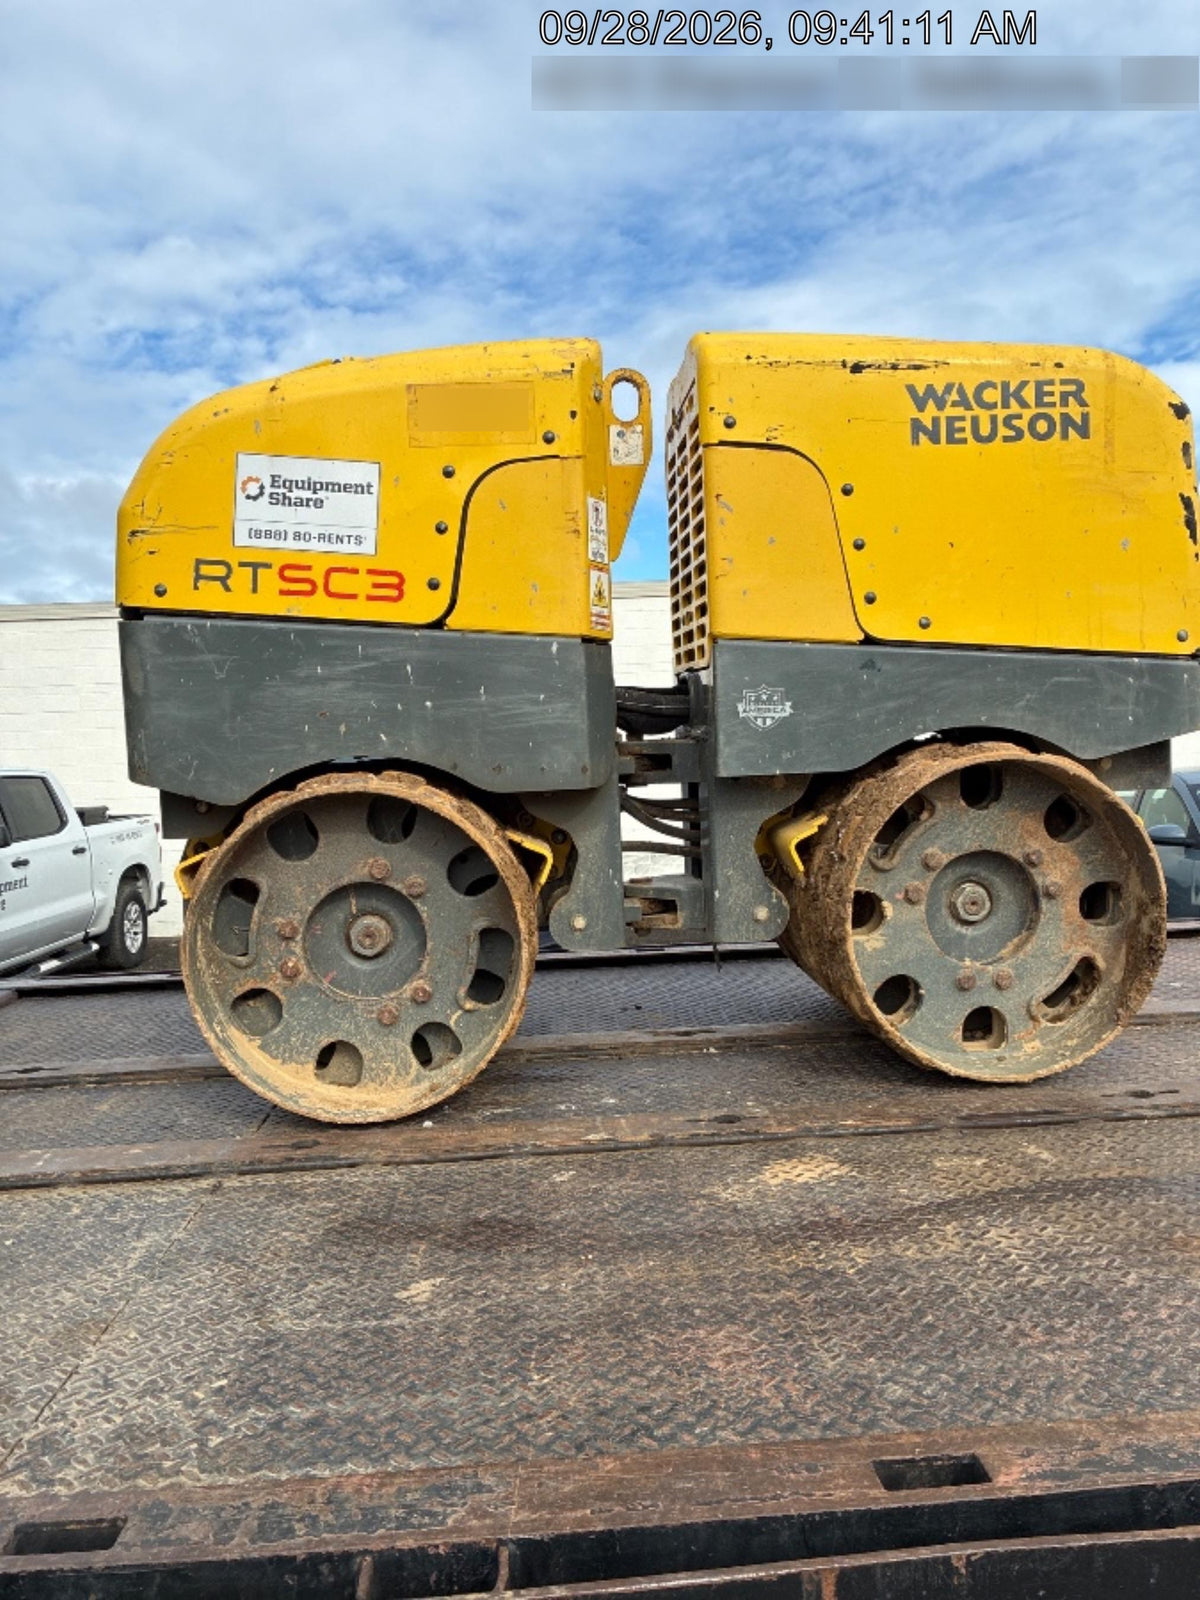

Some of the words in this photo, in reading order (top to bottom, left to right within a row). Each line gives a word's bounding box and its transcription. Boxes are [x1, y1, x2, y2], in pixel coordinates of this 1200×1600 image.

[905, 378, 1090, 413] WACKER
[910, 411, 1090, 446] NEUSON
[269, 474, 374, 495] Equipment
[268, 492, 324, 509] Share
[293, 530, 364, 546] 80-RENTS
[193, 558, 406, 603] RTSC3
